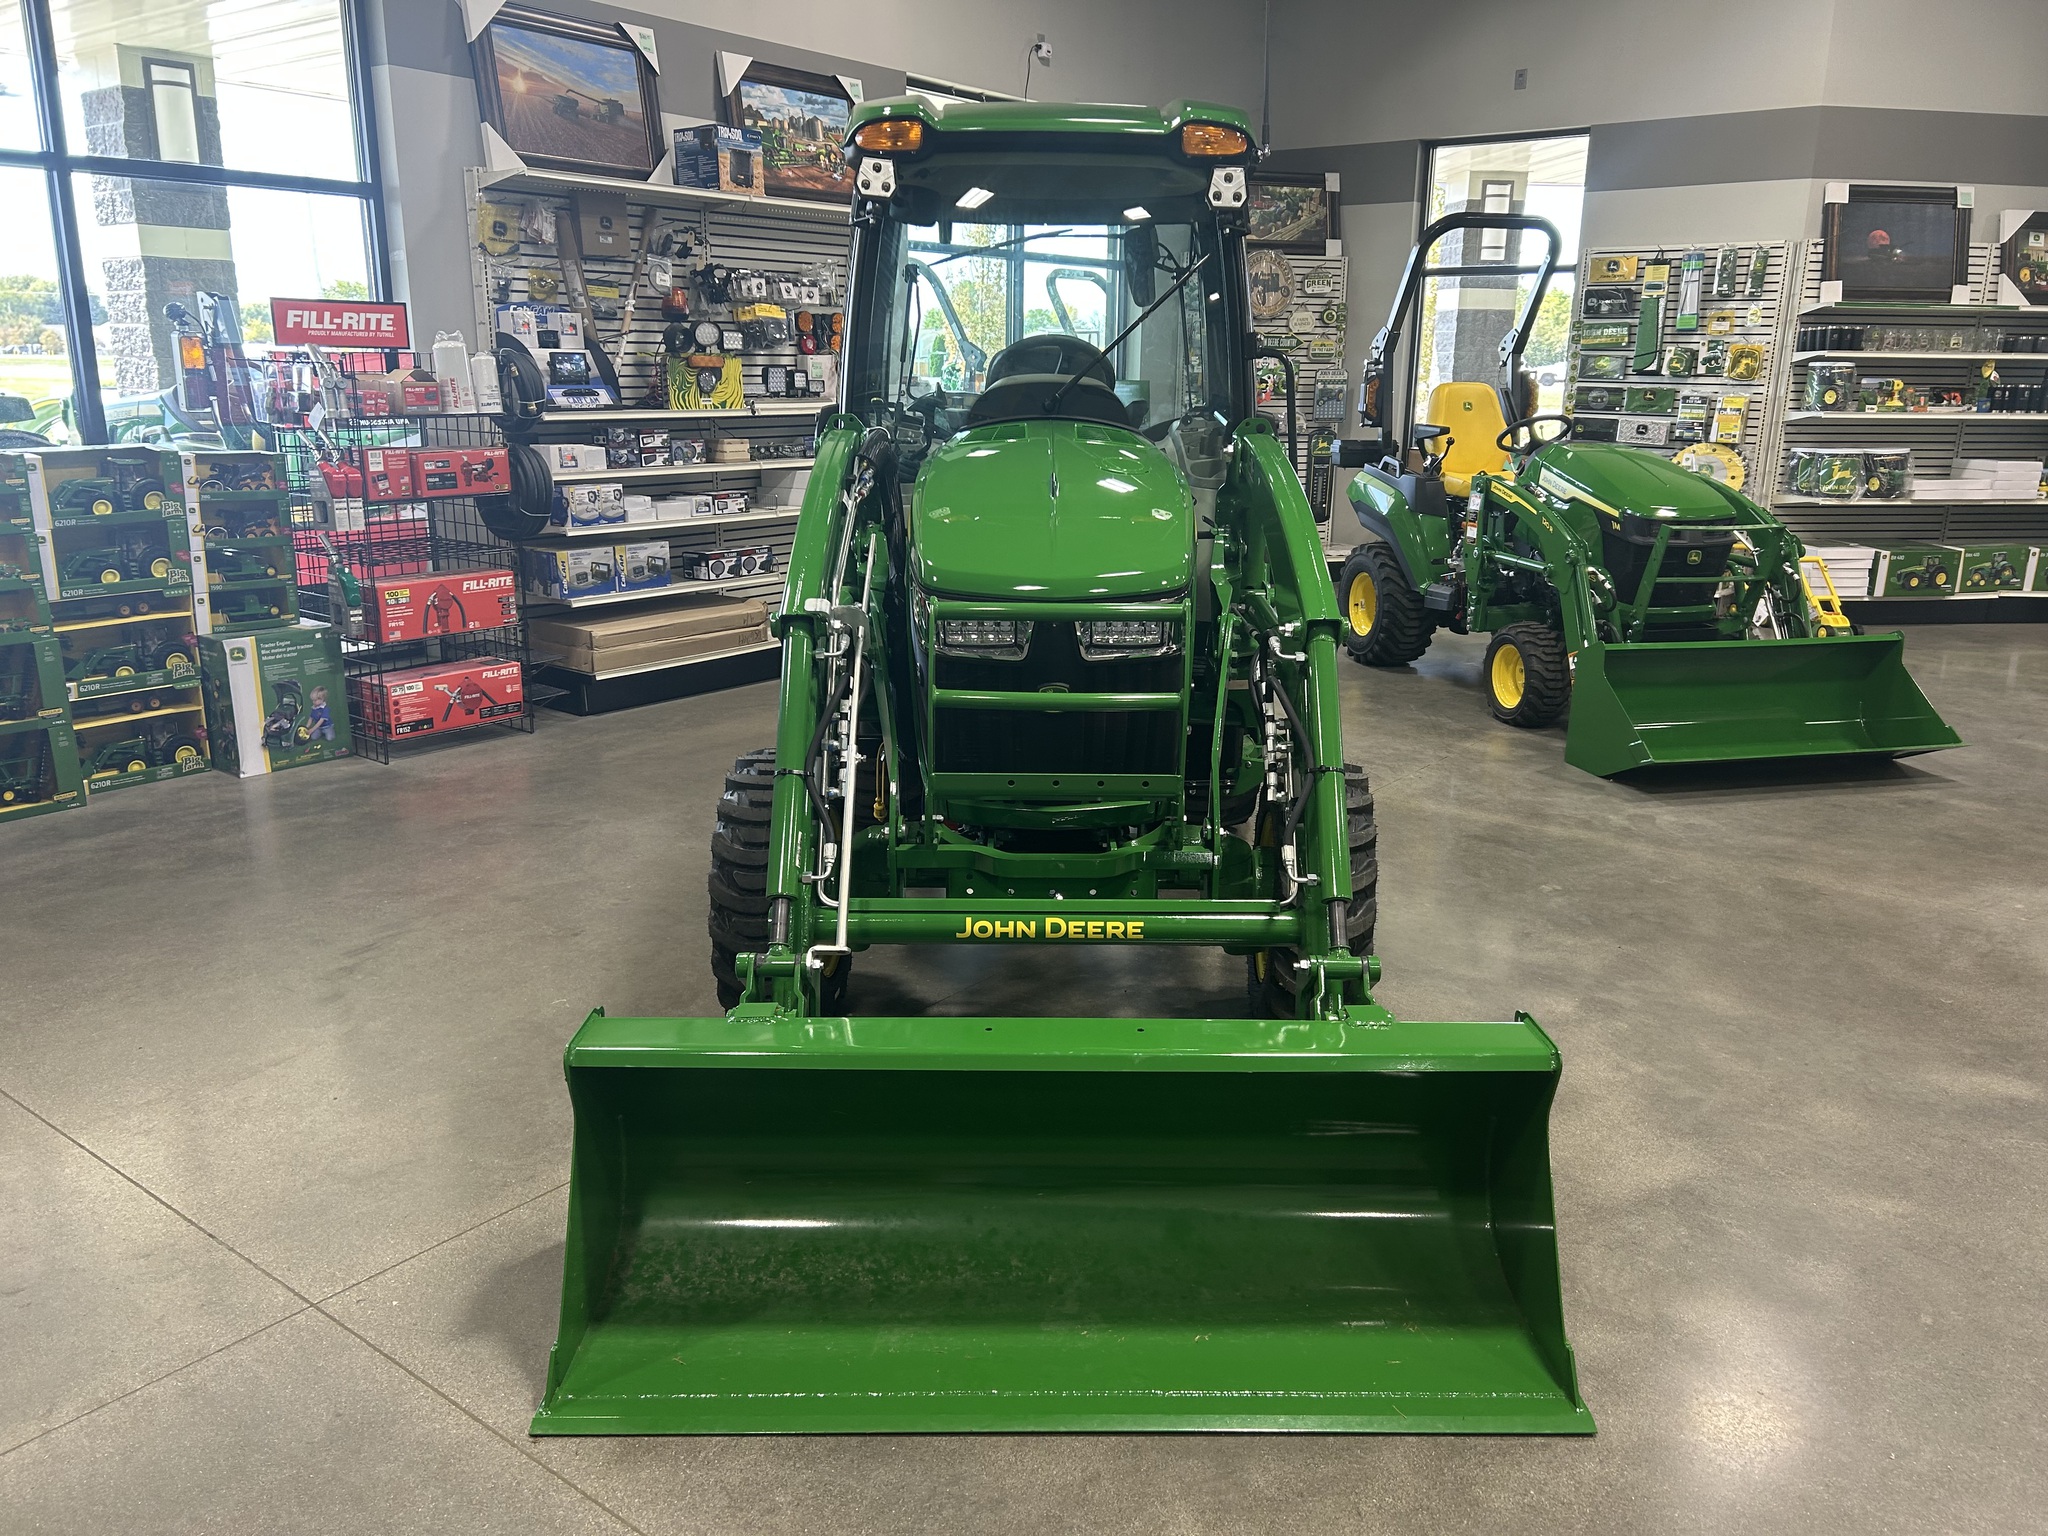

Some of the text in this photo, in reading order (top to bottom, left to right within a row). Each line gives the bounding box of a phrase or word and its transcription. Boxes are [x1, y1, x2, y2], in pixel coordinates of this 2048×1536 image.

[1306, 279, 1332, 288] GREEN
[286, 309, 396, 331] FILL-RITE
[1583, 327, 1628, 337] JOHN DEERE
[1267, 338, 1280, 347] DEERE
[1280, 338, 1298, 347] COUNTRY
[1542, 475, 1568, 495] JOHN DEERE
[1493, 485, 1513, 499] JOHN DEERE
[161, 501, 180, 511] Big
[161, 508, 183, 517] farm
[55, 518, 77, 527] 6210R
[1611, 520, 1621, 531] 1M
[168, 569, 187, 579] Big
[618, 555, 627, 588] CabCAM
[168, 576, 190, 585] farm
[560, 560, 569, 595] CabCAM
[462, 575, 513, 592] FILL-RITE
[62, 588, 84, 598] 6210R
[260, 641, 276, 649] Tractor
[173, 662, 193, 672] Big
[173, 669, 195, 679] farm
[482, 666, 519, 679] FILL-RITE
[79, 682, 100, 692] 6210R
[396, 726, 411, 735] FR152
[183, 755, 202, 766] Big
[182, 762, 204, 773] farm
[90, 779, 111, 790] 6210R
[955, 917, 1145, 939] JOHN DEERE
